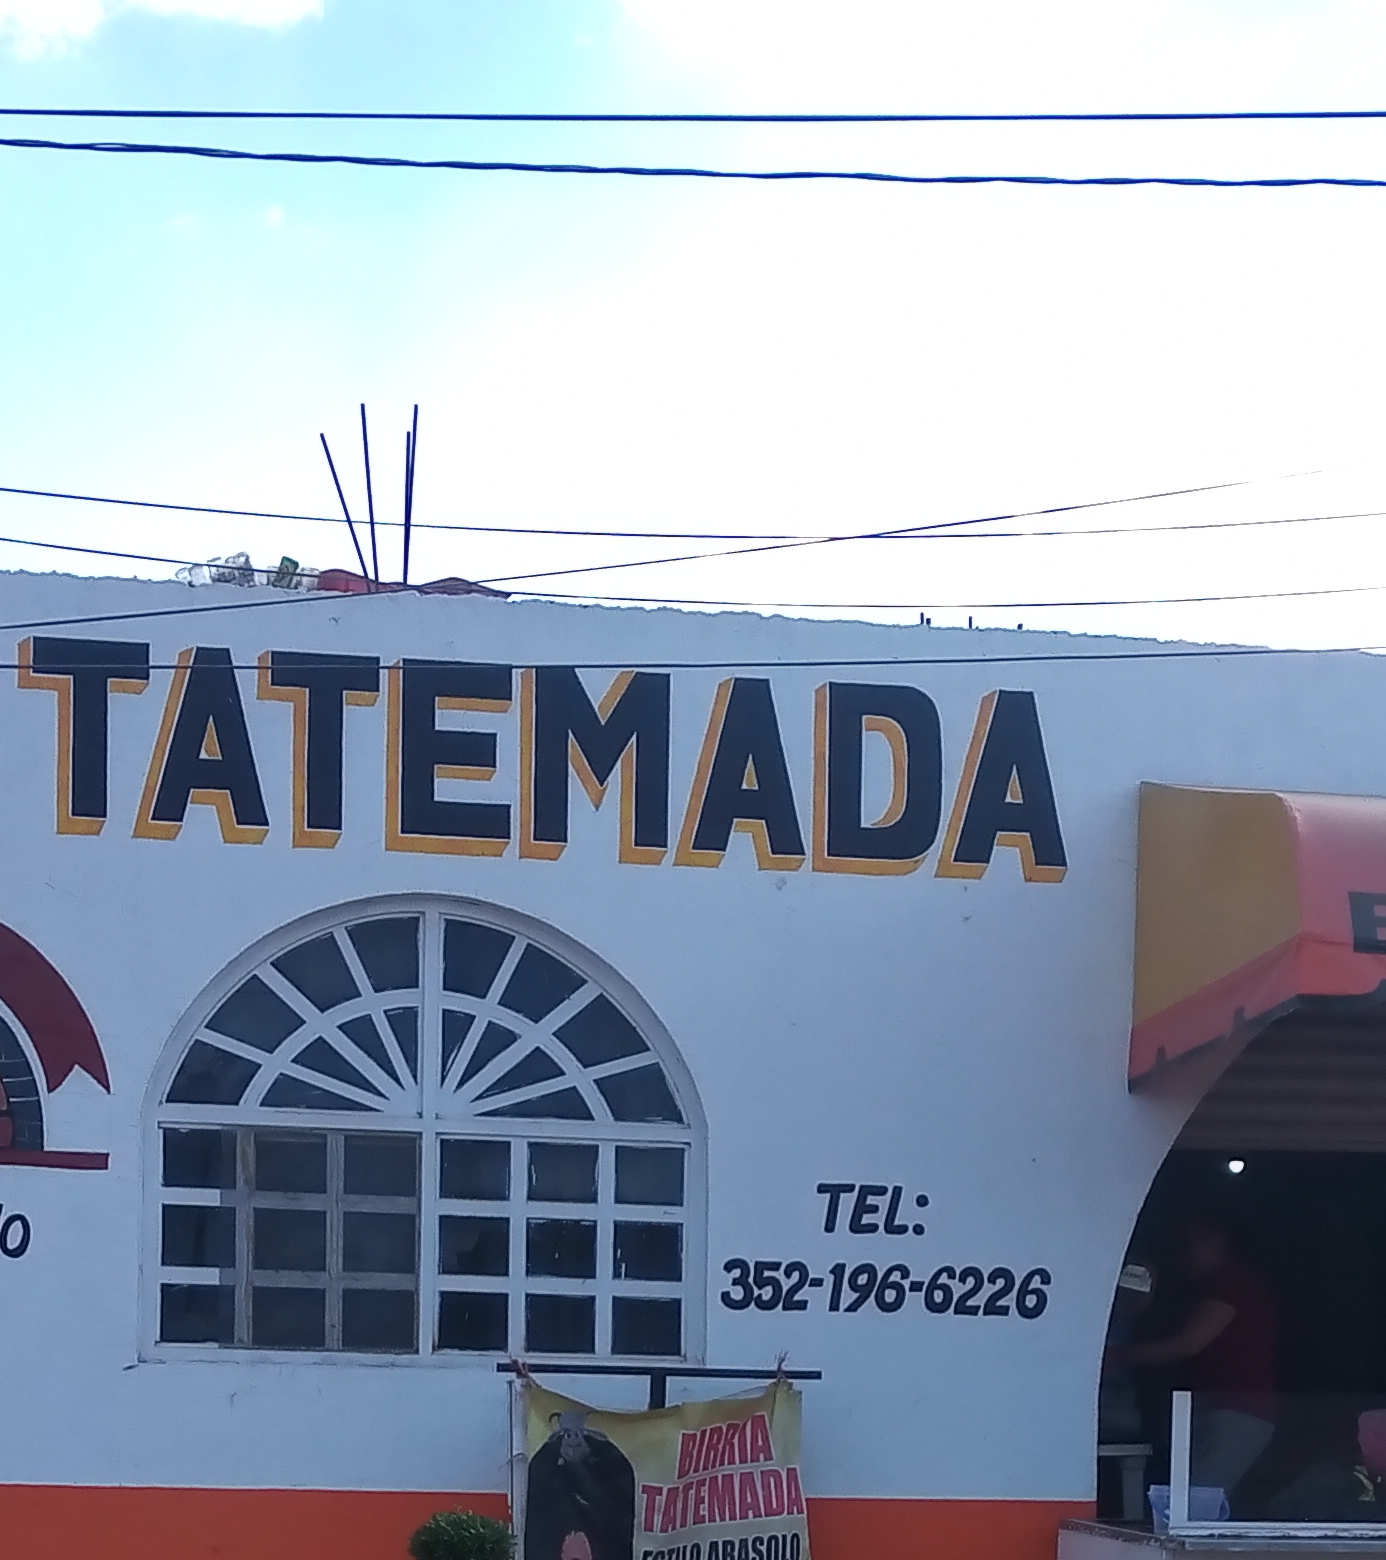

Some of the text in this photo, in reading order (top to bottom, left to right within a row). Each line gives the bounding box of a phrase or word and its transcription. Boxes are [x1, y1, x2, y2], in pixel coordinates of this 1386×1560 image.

[16, 636, 1069, 884] TATEMADA
[816, 1182, 931, 1236] TEL:
[720, 1257, 1053, 1320] 352-196-6226
[677, 1413, 774, 1480] BIRRIA
[641, 1466, 806, 1533] TATEMADA
